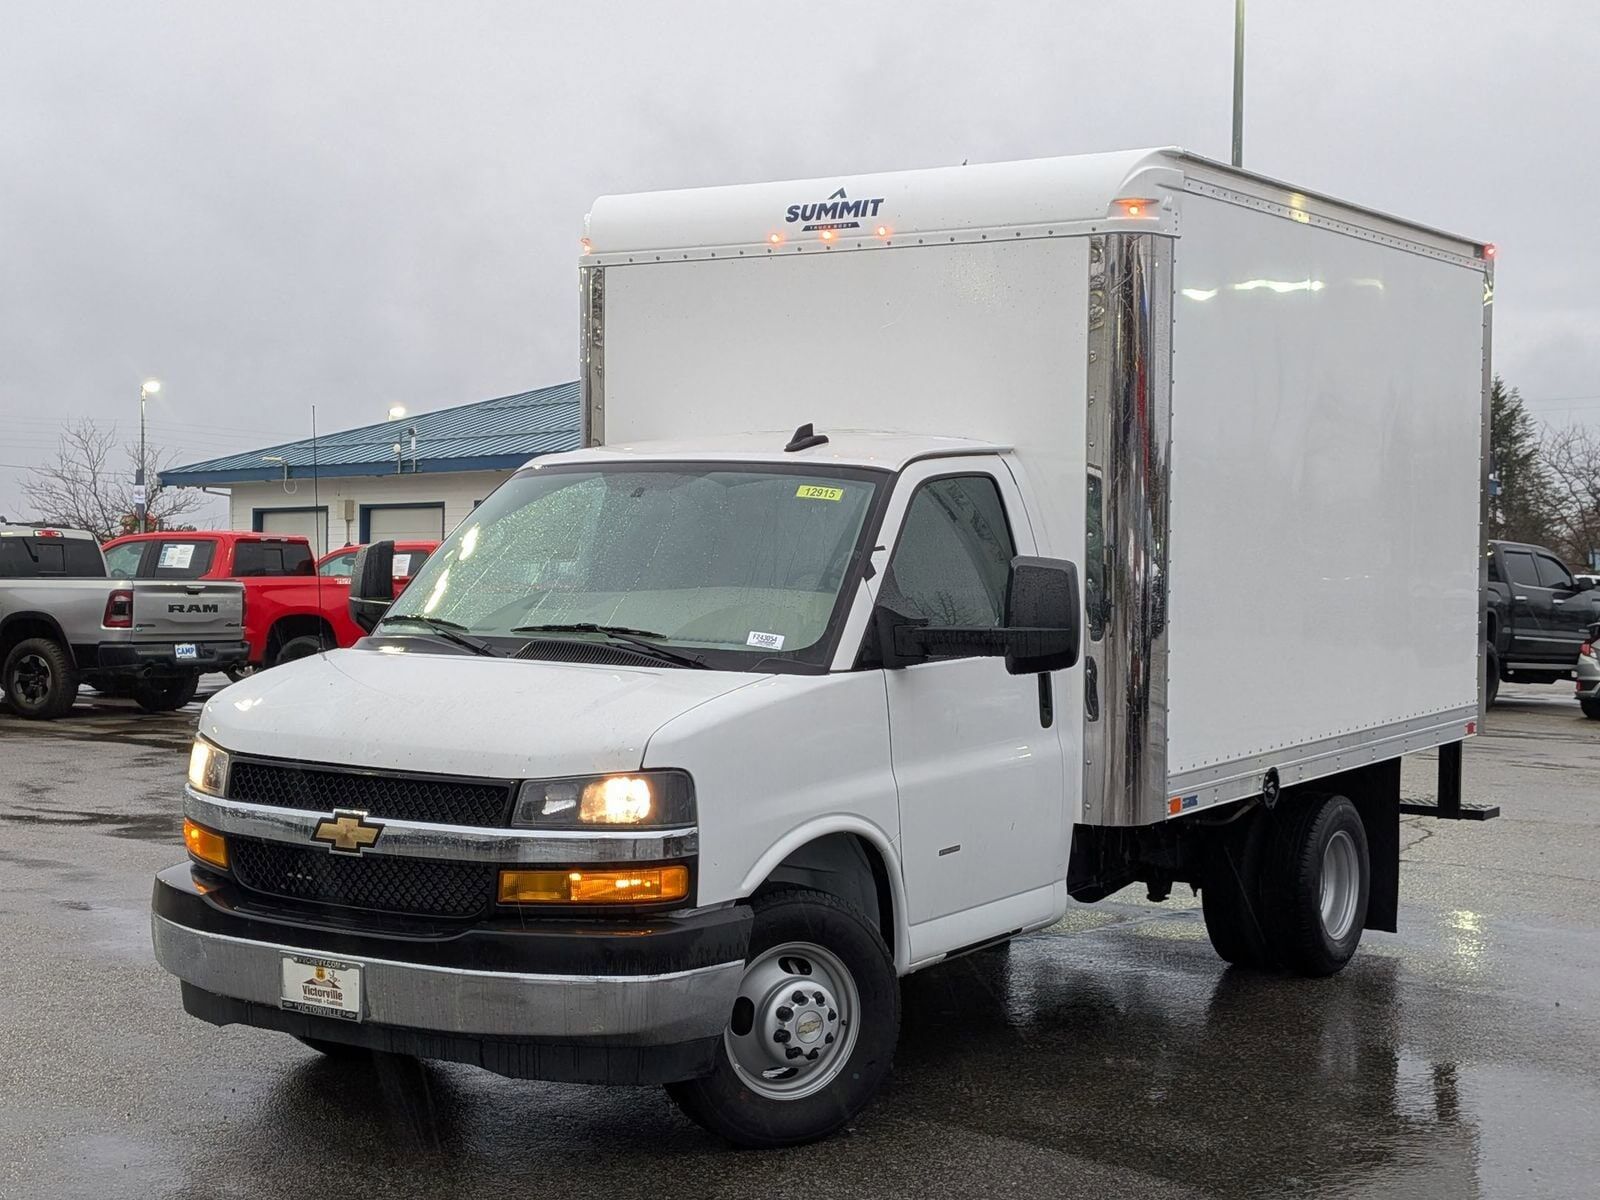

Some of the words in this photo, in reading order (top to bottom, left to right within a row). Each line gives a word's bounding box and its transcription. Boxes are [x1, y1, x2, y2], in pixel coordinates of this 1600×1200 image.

[785, 198, 884, 223] SUMMIT
[805, 487, 836, 498] 12915
[168, 604, 219, 613] RAM
[176, 646, 195, 655] CAMP
[302, 985, 343, 1001] Victorville
[297, 1004, 340, 1017] VICTORVILLE
